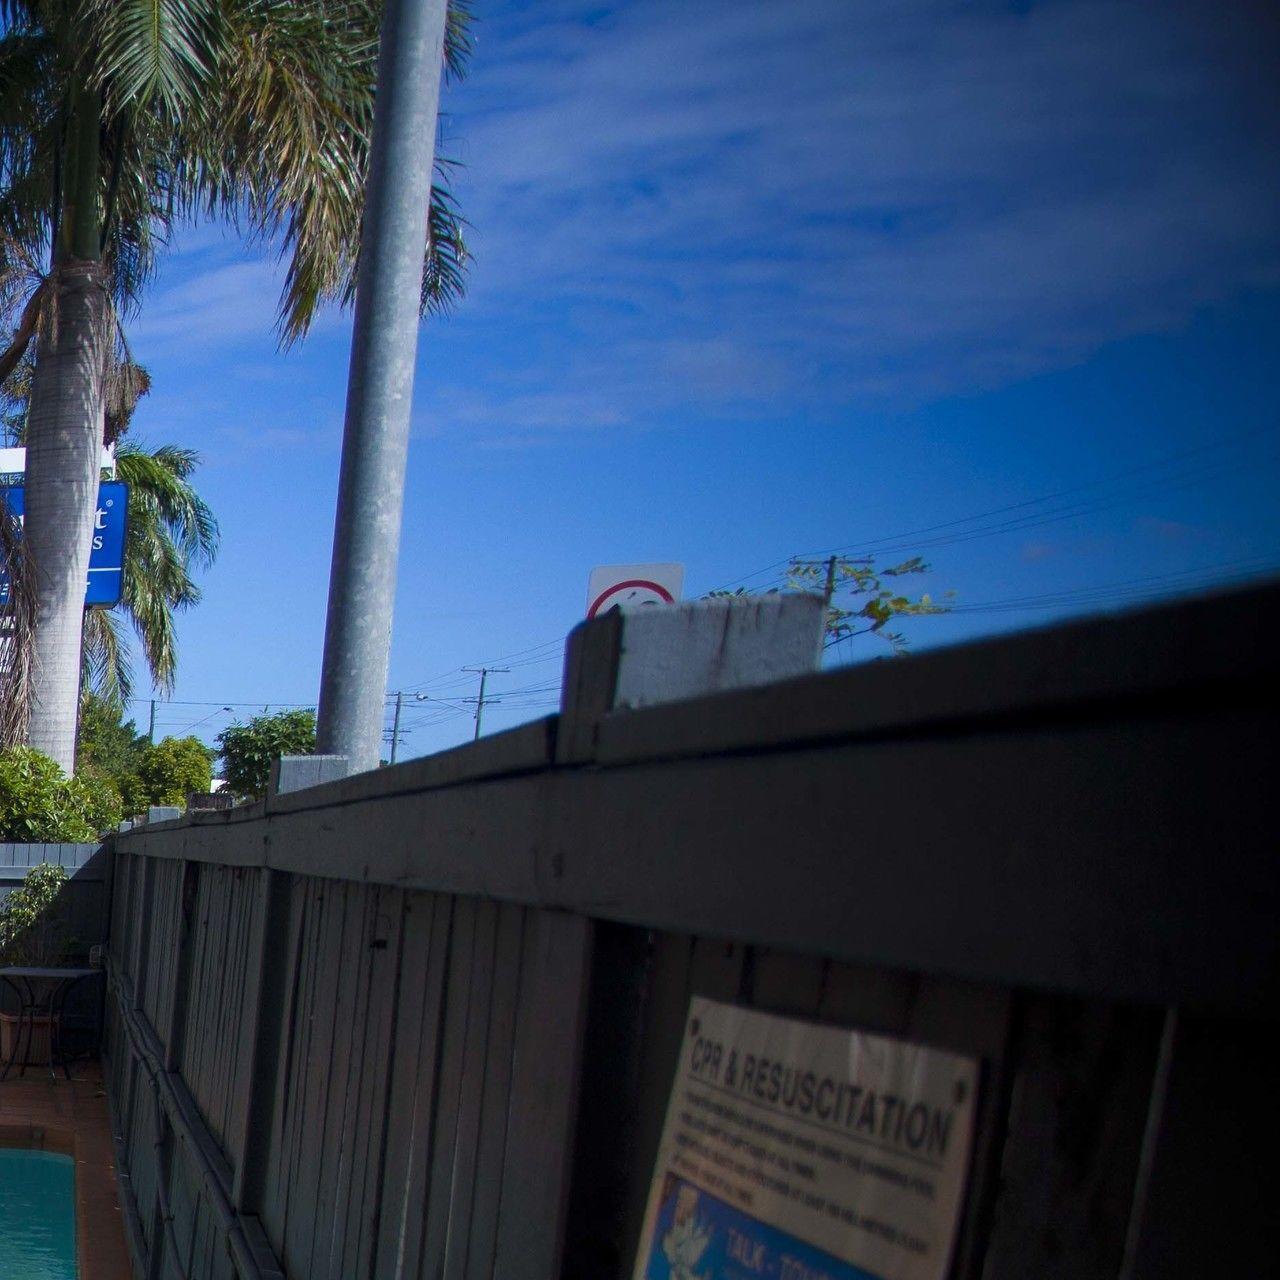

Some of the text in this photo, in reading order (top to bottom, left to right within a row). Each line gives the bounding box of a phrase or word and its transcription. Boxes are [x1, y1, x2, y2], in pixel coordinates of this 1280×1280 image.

[691, 1037, 954, 1158] CPR & RESUSCITATION
